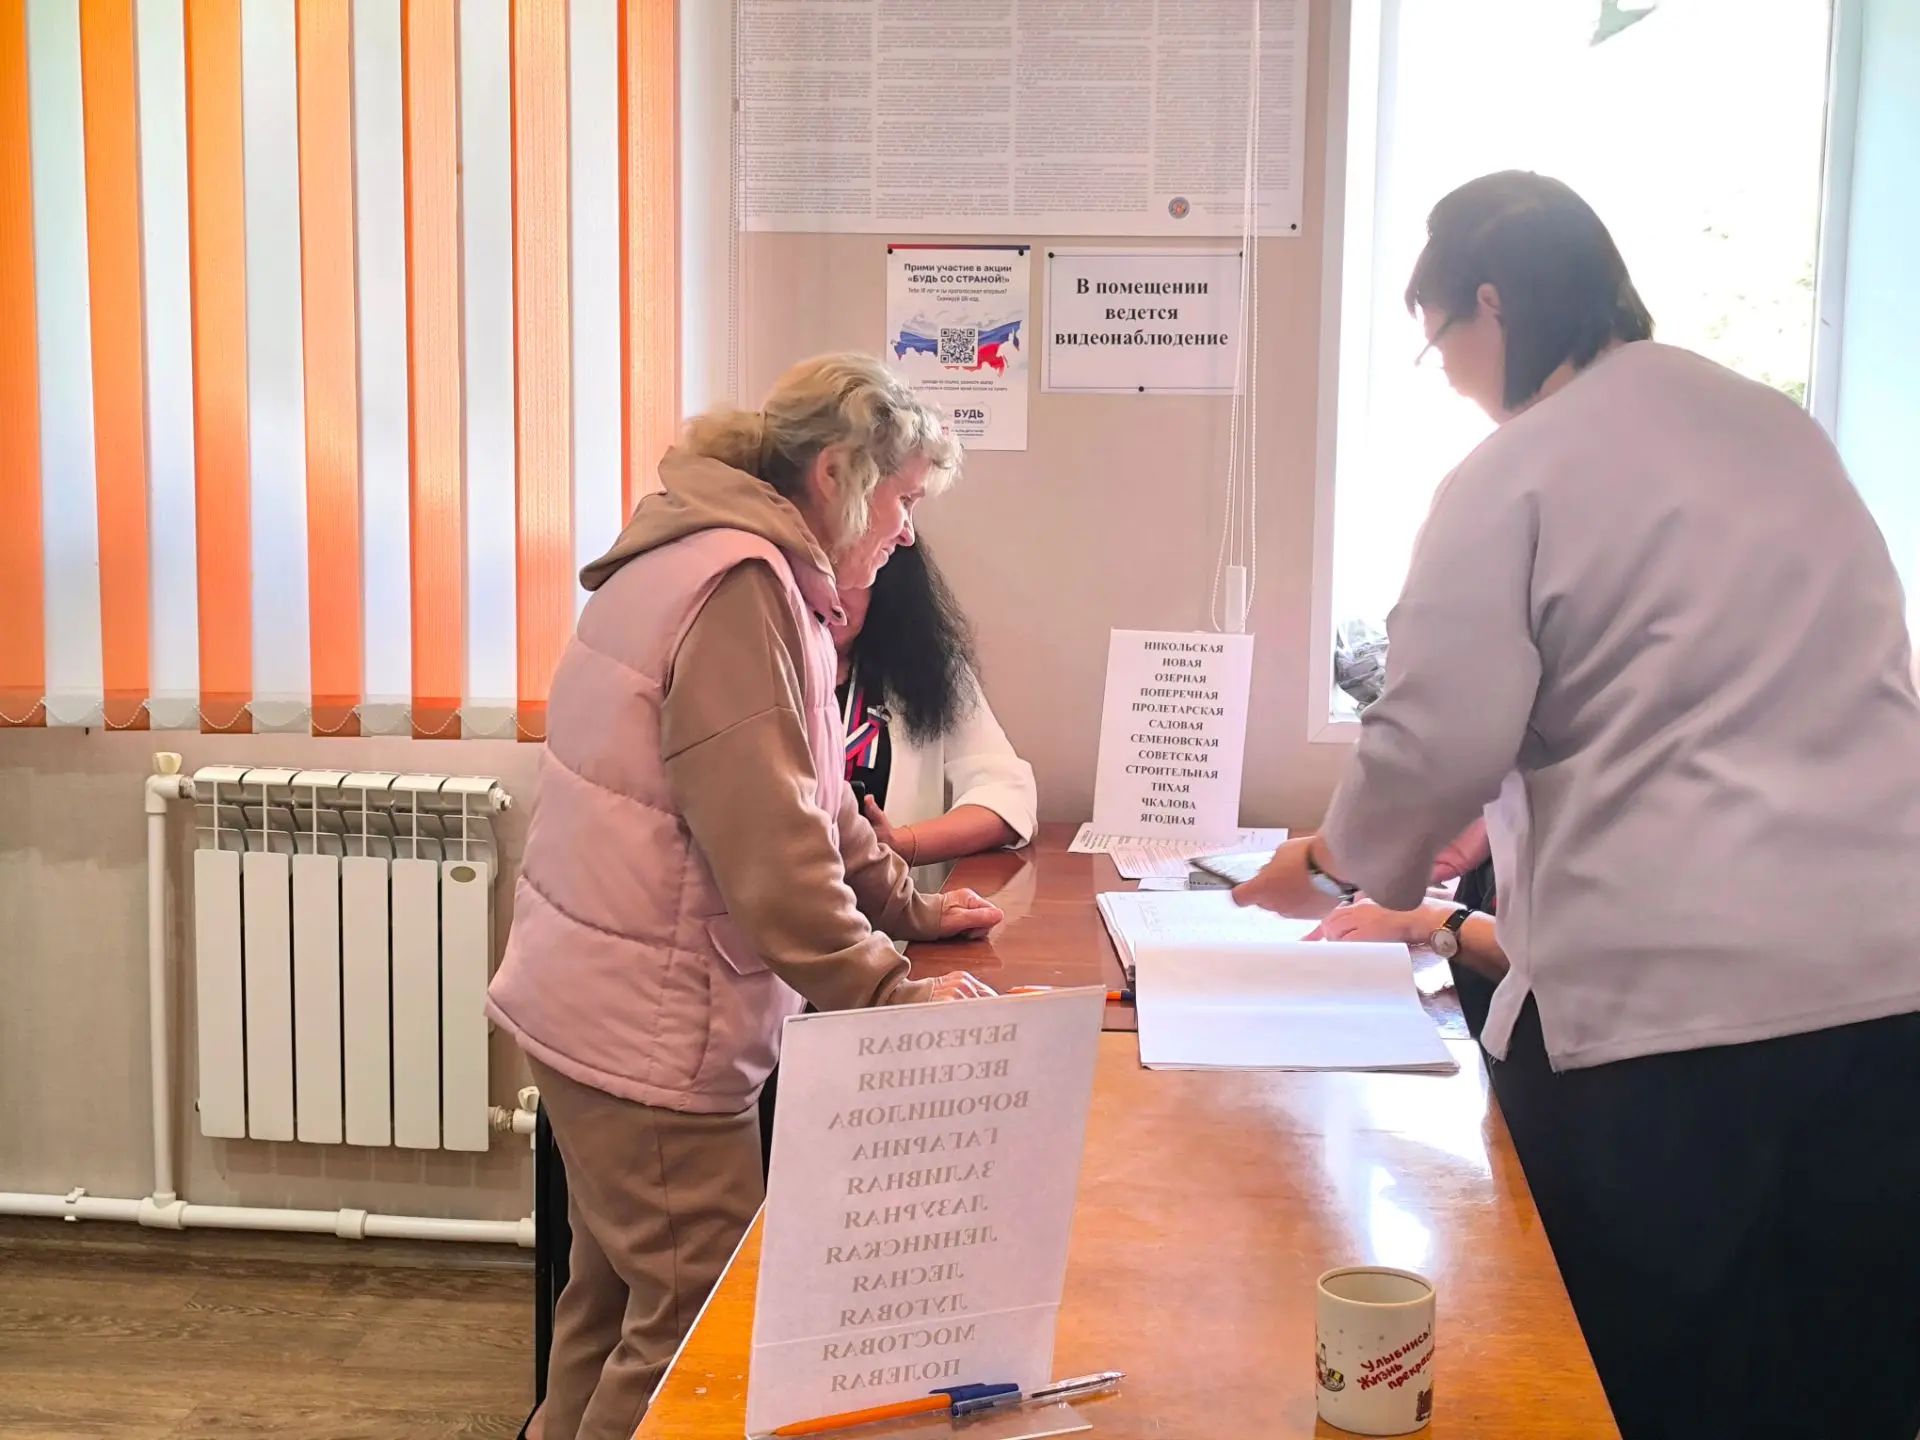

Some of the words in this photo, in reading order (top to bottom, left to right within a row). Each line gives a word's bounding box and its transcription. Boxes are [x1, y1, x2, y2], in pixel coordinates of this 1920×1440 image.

[904, 263, 935, 272] Прими
[937, 265, 974, 273] участие
[984, 265, 1012, 273] акции
[907, 275, 938, 283] «БУДЬ
[940, 275, 954, 283] СО
[956, 274, 1010, 283] СТРАНОЙ!»
[1076, 278, 1089, 294] В
[1096, 281, 1208, 296] помещении
[1105, 307, 1178, 321] ведется
[1055, 330, 1228, 346] видеонаблюдение
[954, 409, 984, 418] БУДЬ
[1144, 641, 1224, 653] НИКОЛЬСКАЯ
[1162, 658, 1202, 668] НОВАЯ
[1154, 673, 1207, 684] ОЗЕРНАЯ
[1140, 687, 1218, 700] ПОПЕРЕЧНАЯ
[1131, 702, 1224, 716] ПРОЛЕТАРСКАЯ
[1148, 719, 1203, 731] САДОВАЯ
[1130, 733, 1219, 747] СЕМЕНОВСКАЯ
[1138, 750, 1208, 763] СОВЕТСКАЯ
[1125, 764, 1218, 779] СТРОИТЕЛЬНАЯ
[1151, 782, 1190, 793] ТИХАЯ
[1141, 797, 1196, 810] ЧКАЛОВА
[1140, 813, 1195, 826] ЯГОДНАЯ
[1360, 1322, 1432, 1373] Улыбнись!
